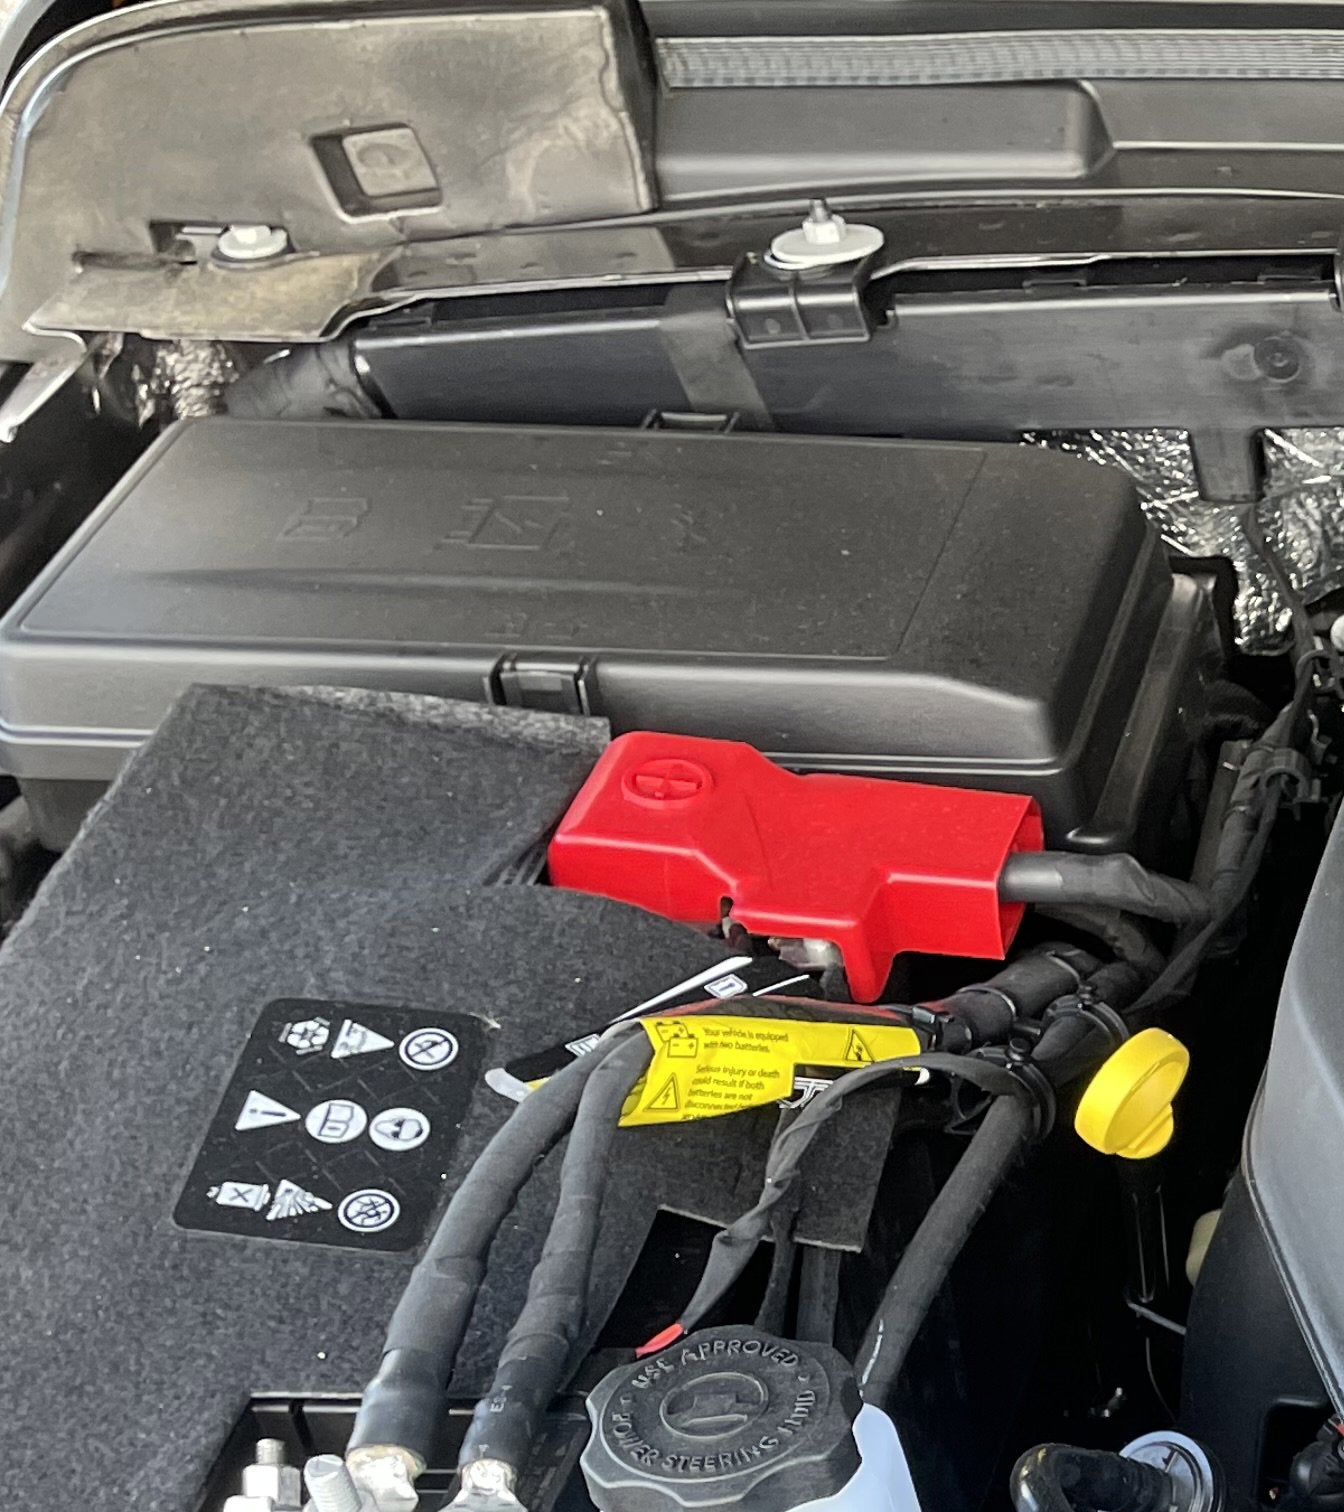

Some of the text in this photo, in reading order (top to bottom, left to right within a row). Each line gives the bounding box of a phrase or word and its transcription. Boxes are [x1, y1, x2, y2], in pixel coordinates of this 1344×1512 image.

[722, 1064, 747, 1078] injury
[747, 1069, 758, 1077] or
[758, 1068, 781, 1079] death
[712, 1078, 738, 1088] result
[745, 1081, 766, 1090] both
[723, 1092, 737, 1100] are
[738, 1092, 753, 1101] not
[631, 1339, 799, 1391] USE APPROVED
[661, 1434, 781, 1473] STEERING
